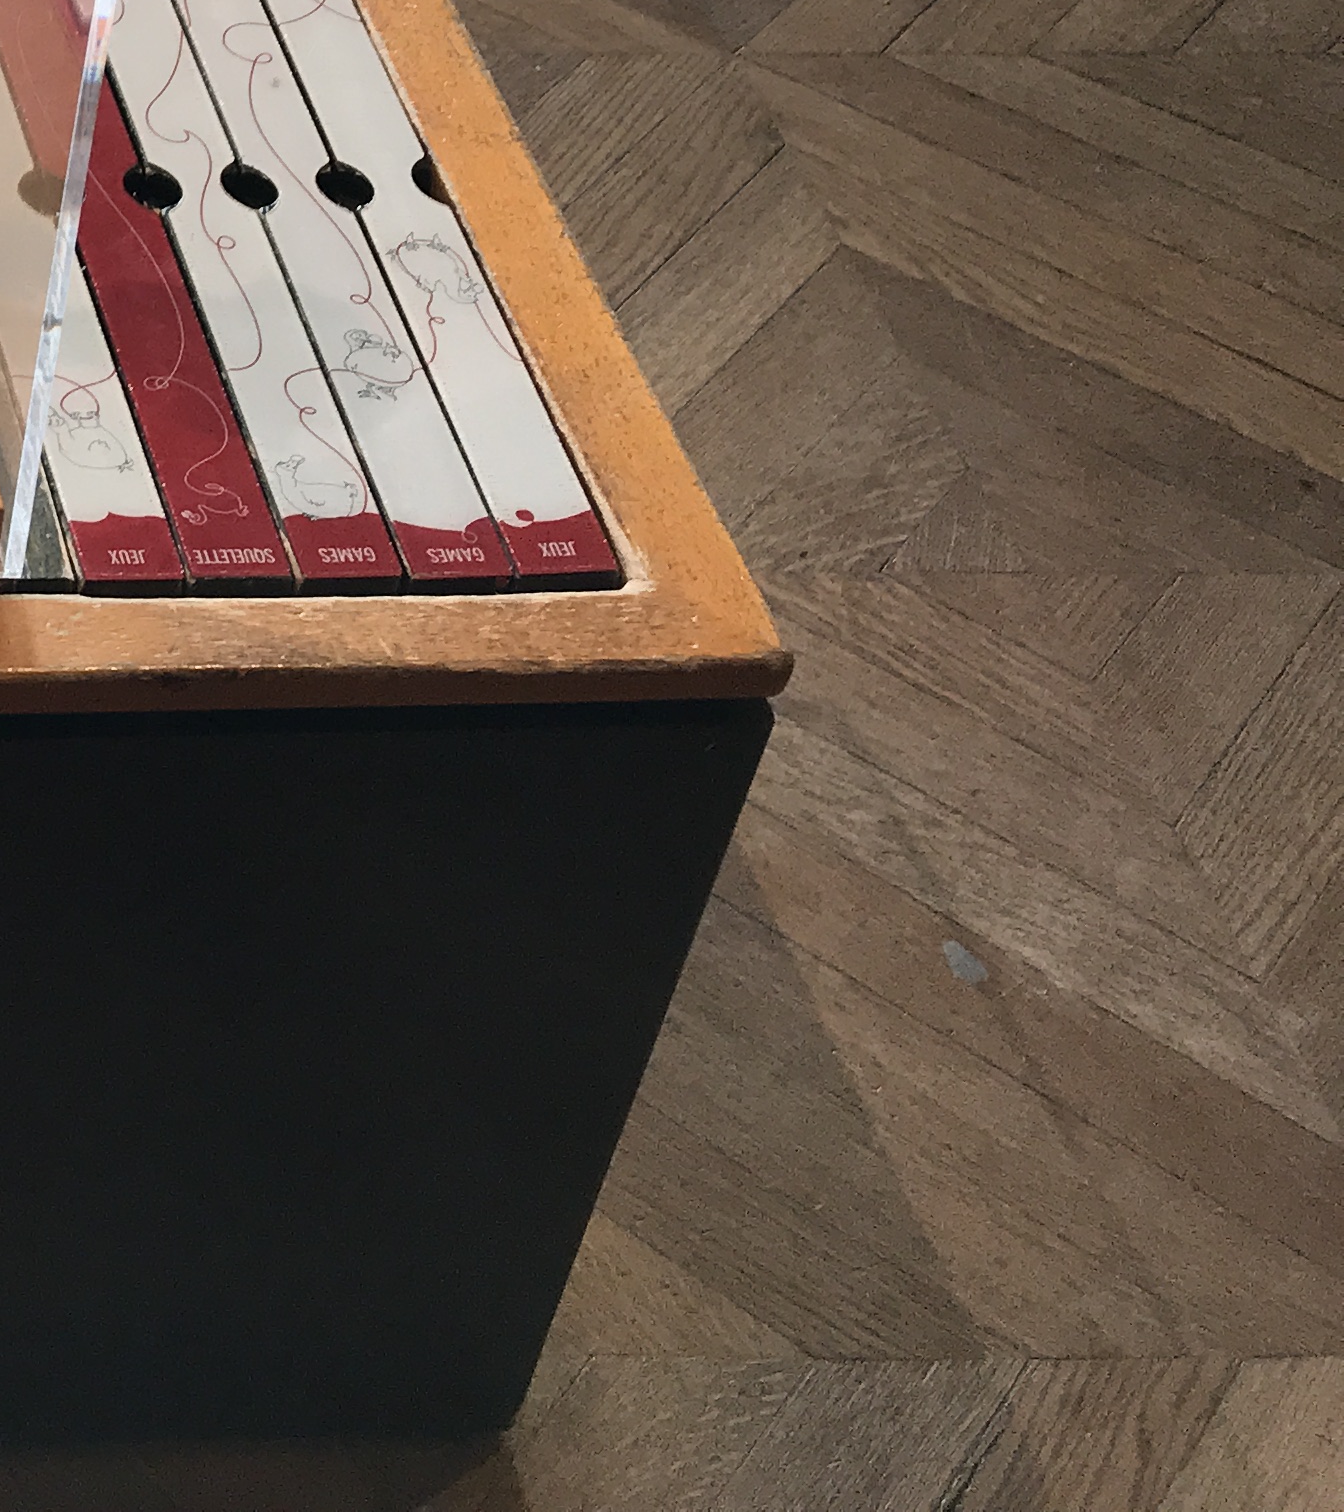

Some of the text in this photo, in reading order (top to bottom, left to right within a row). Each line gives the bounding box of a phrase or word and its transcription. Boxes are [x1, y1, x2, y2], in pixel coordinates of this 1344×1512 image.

[108, 549, 148, 566] JEUX
[194, 548, 276, 565] SQUELETTE
[317, 546, 377, 563] GAMES
[426, 546, 485, 563] GAMES
[538, 541, 577, 558] JEUX
